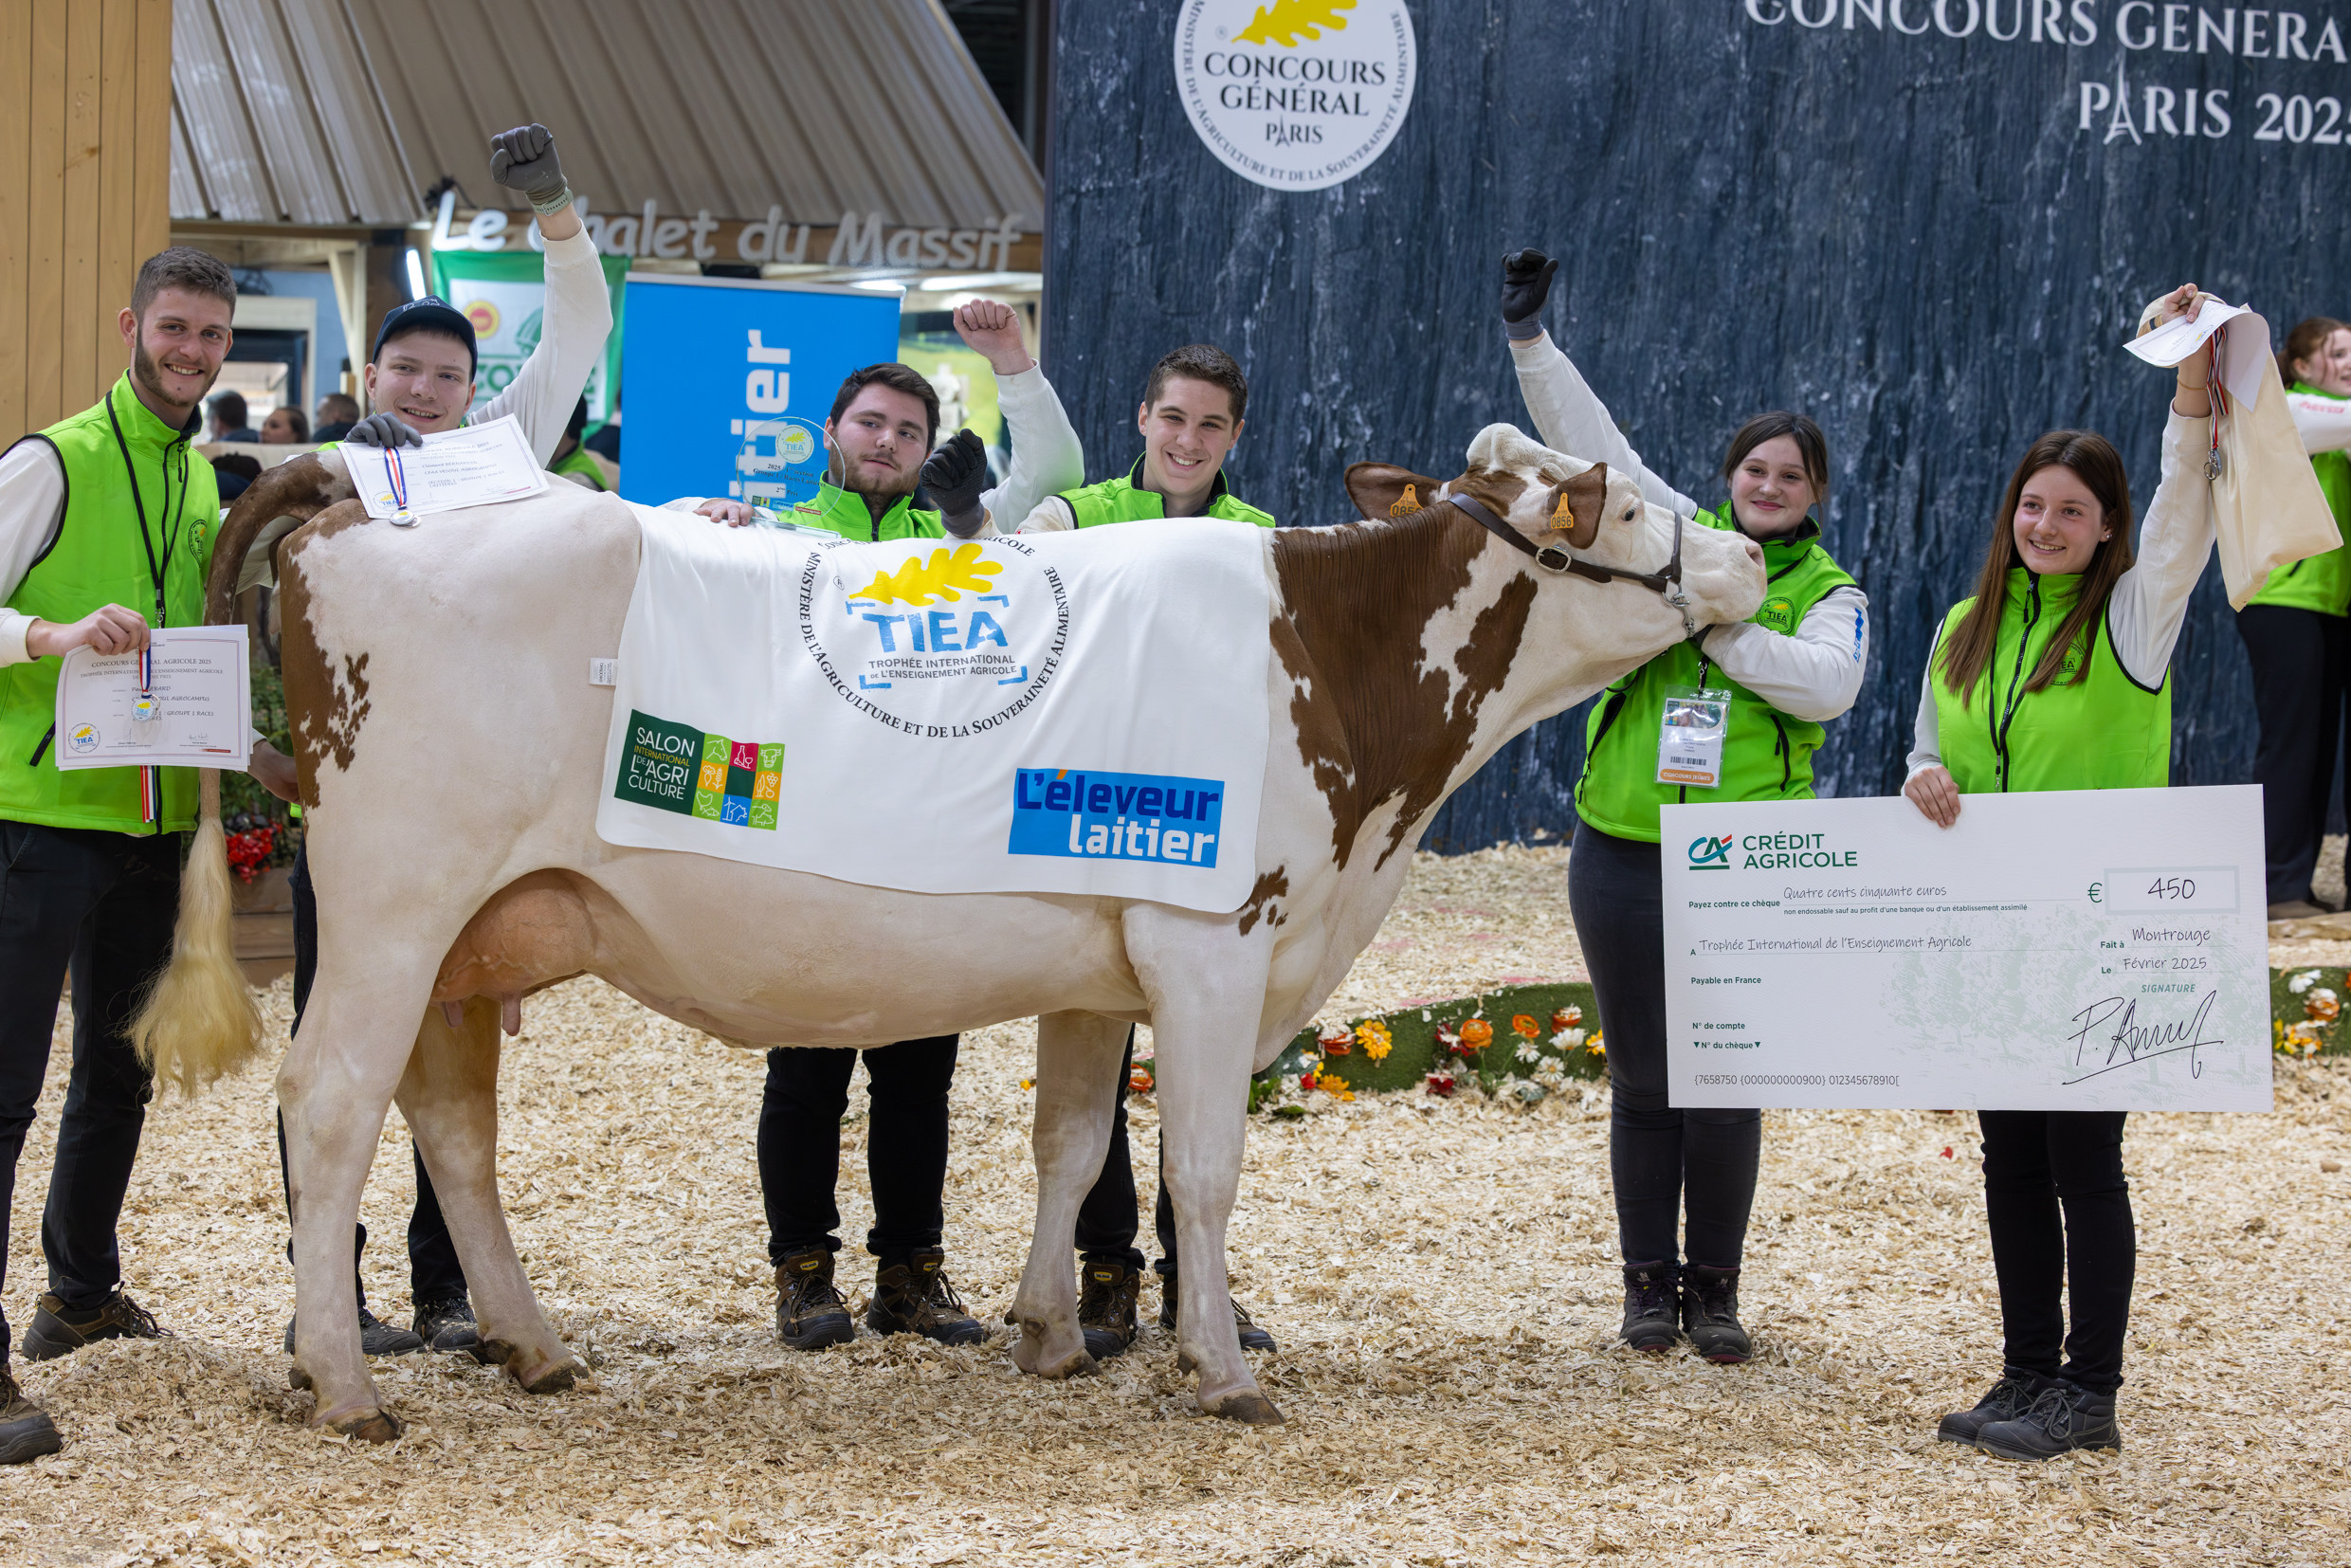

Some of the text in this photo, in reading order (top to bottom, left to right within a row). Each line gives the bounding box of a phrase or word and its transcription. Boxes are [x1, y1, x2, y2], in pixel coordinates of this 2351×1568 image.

[1204, 52, 1386, 86] CONCOURS
[1220, 80, 1370, 117] GÉNÉRAL
[2079, 55, 2351, 145] PARIS 202
[1186, 78, 1199, 96] DE
[1193, 99, 1267, 176] L'AGRICULTURE
[1269, 168, 1286, 180] ET
[1288, 170, 1306, 182] DE
[1309, 170, 1325, 180] LA
[1266, 115, 1323, 147] PARIS
[431, 191, 508, 251] Le
[738, 204, 811, 264] du
[828, 211, 1024, 272] Massif
[754, 468, 775, 478] Groupe
[1393, 505, 1421, 516] 085
[1552, 516, 1572, 527] 0856
[1767, 611, 1787, 622] TIEA
[862, 611, 1009, 653] TIEA
[800, 552, 1069, 738] MINISTÈRE DE L'AGRICULTURE ET DE LA SOUVERAINETÉ ALIMENTAIRE
[868, 654, 1015, 669] TROPHÉE INTERNATIONAL
[881, 667, 966, 679] L'ENSEIGNEMENT
[971, 665, 1017, 675] AGRICOLE
[636, 726, 696, 757] SALON
[634, 745, 690, 767] INTERNATIONAL
[636, 756, 647, 767] DE
[630, 755, 689, 786] L'AGRI
[629, 775, 685, 800] CULTURE
[1018, 769, 1220, 822] L'éleveur
[1068, 813, 1215, 863] laitier
[1742, 831, 1825, 851] CRÉDIT
[1743, 851, 1858, 869] AGRICOLE
[1688, 901, 1711, 909] Payez
[1713, 900, 1739, 908] contre
[1752, 900, 1780, 909] chèque
[1783, 886, 1823, 900] Quatre
[1827, 887, 1857, 898] cents
[1860, 885, 1913, 902] cinquante
[1916, 885, 1947, 897] euros
[2087, 878, 2196, 903] € 450
[1860, 906, 1878, 915] profit
[1900, 906, 1924, 915] banque
[1953, 904, 1998, 913] établissement
[1699, 938, 1743, 952] Trophée
[1747, 937, 1822, 951] International
[1826, 937, 1839, 948] de
[1842, 936, 1923, 952] l'Enseignement
[1927, 936, 1972, 952] Agricole
[2120, 940, 2124, 949] à
[2132, 927, 2211, 946] Montrouge
[2123, 957, 2167, 970] Février
[2172, 957, 2207, 970] 2025
[1691, 976, 1722, 986] Payable
[2141, 984, 2196, 993] SIGNATURE
[1715, 1022, 1745, 1030] compte
[1724, 1041, 1753, 1050] chèque
